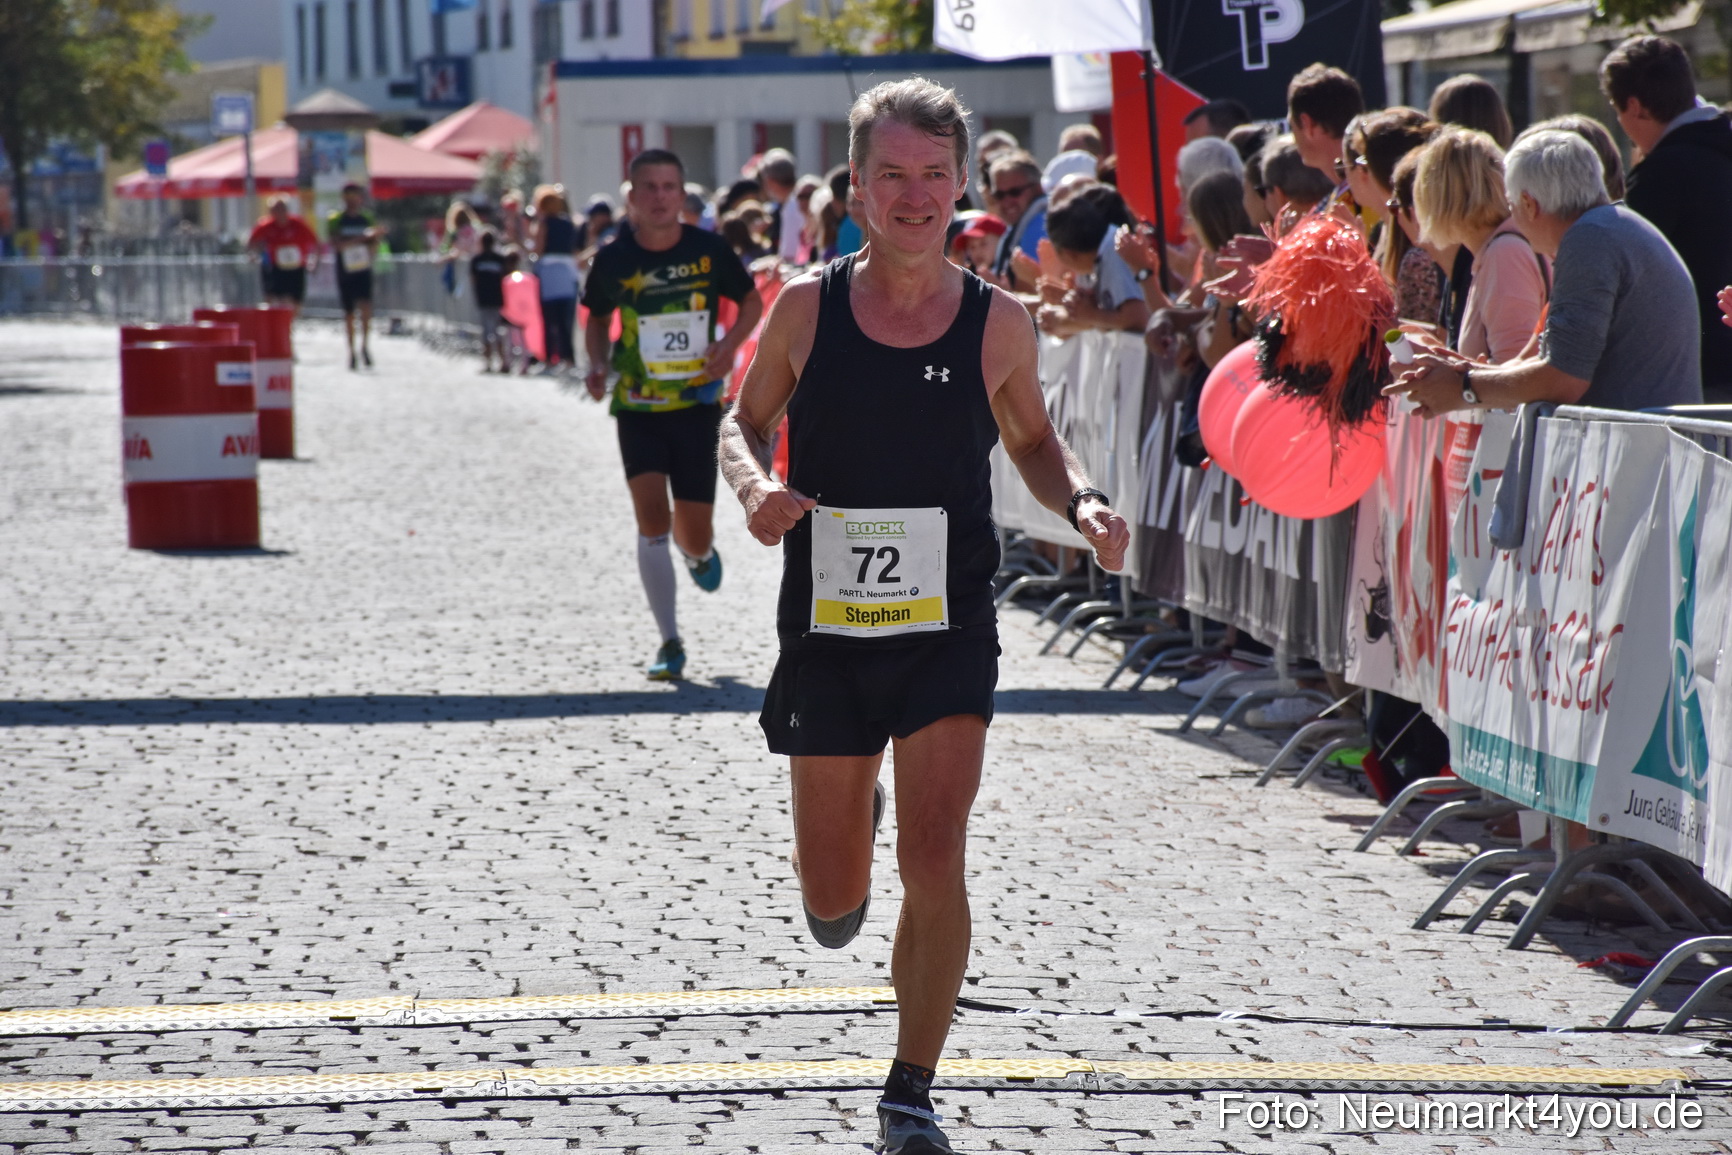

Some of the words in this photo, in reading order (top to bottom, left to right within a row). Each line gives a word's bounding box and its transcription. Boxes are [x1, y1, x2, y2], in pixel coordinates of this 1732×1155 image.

[667, 256, 712, 279] 2018
[664, 331, 690, 352] 29
[845, 521, 906, 535] BOCK
[851, 546, 901, 584] 72
[839, 588, 865, 598] PARTL
[866, 589, 907, 598] Neumarkt
[845, 606, 911, 626] Stephan
[1624, 789, 1653, 820] Jura
